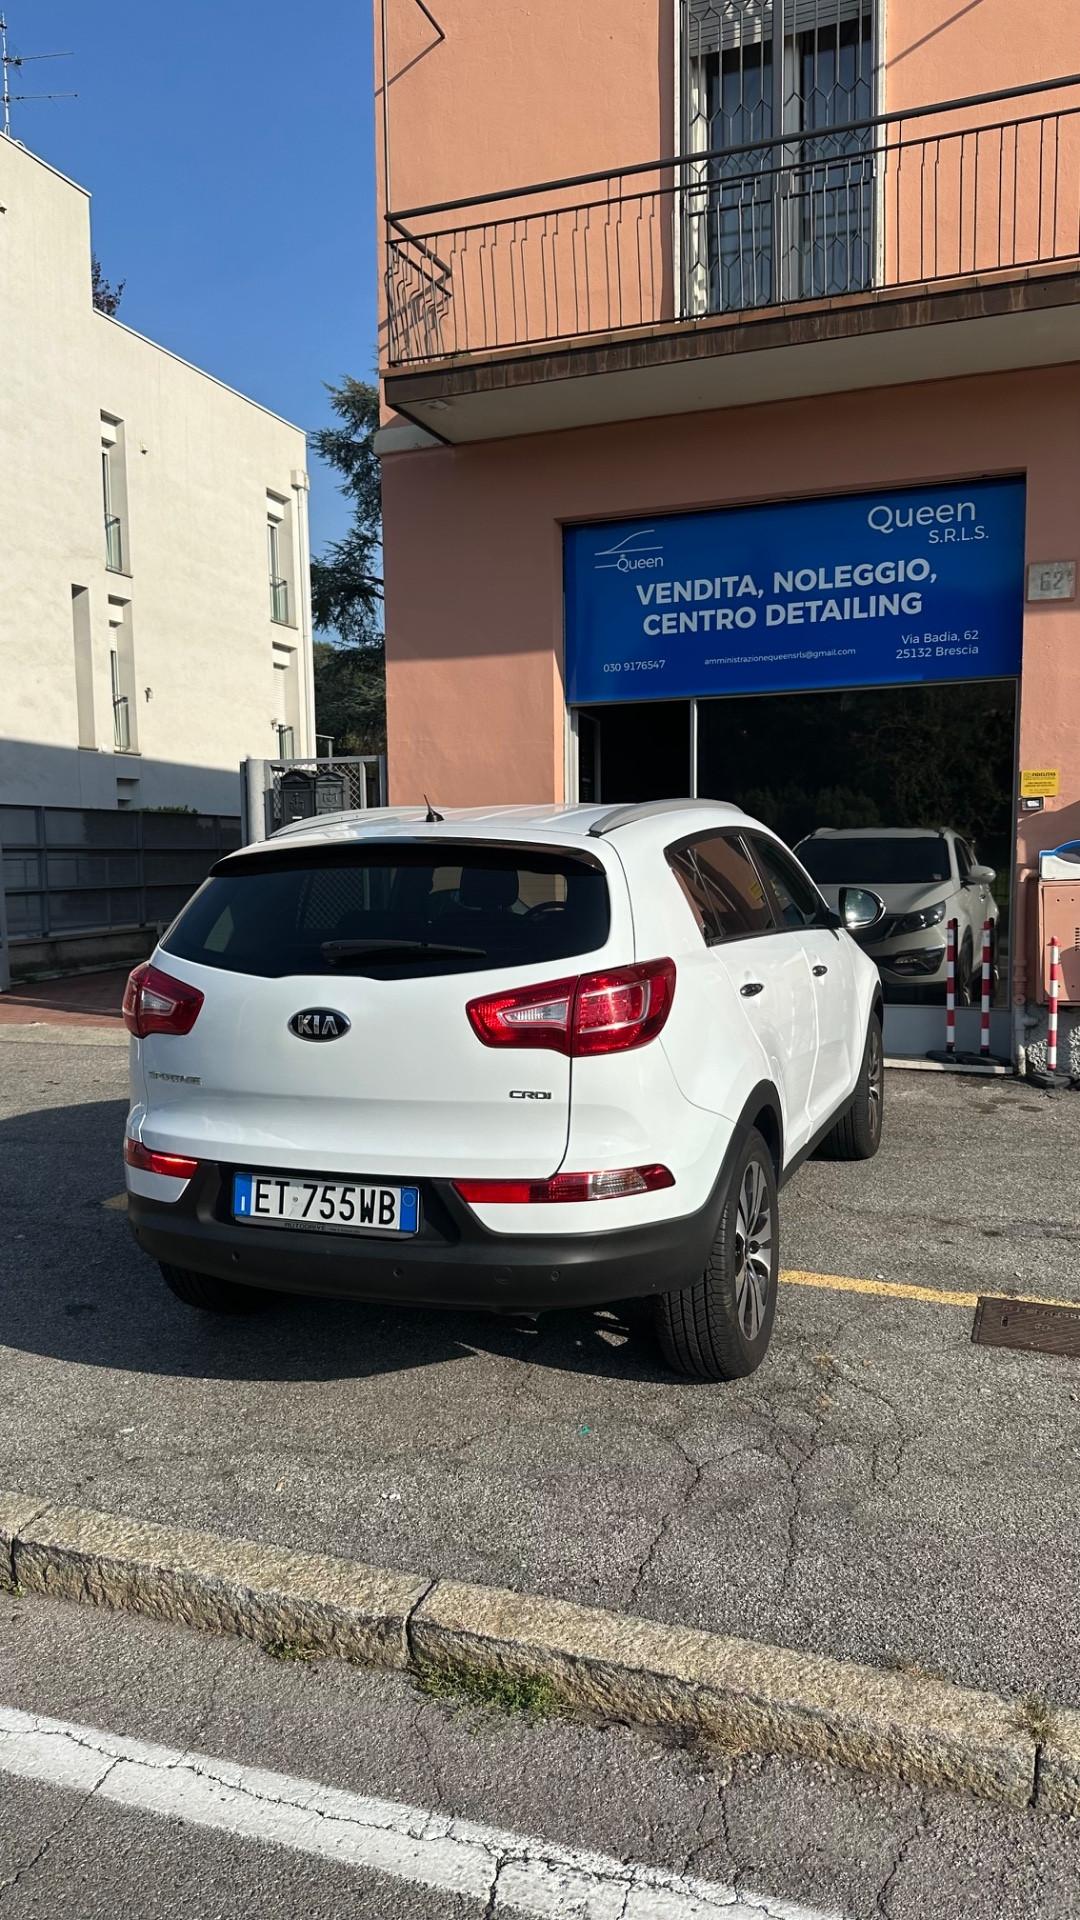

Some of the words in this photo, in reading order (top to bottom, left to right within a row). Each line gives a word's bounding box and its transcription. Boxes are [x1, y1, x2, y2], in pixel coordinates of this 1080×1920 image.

[867, 501, 976, 534] Queen
[928, 525, 989, 544] S.R.L.S.
[616, 556, 664, 573] Queen
[636, 574, 764, 606] VENDITA,
[773, 558, 937, 594] NOLEGGIO,
[643, 606, 757, 636] CENTRO
[766, 592, 922, 627] DETAILING
[901, 633, 920, 645] Via
[923, 631, 960, 644] Badia,
[963, 630, 979, 640] 62
[704, 648, 856, 665] amministrazionequeensrls@gmail.com
[895, 647, 932, 659] 25132
[935, 644, 979, 657] Brescia
[603, 663, 622, 673] 030
[623, 660, 666, 672] 9176547
[297, 1014, 339, 1035] KIA
[254, 1178, 290, 1215] ET
[301, 1183, 397, 1226] 755WB
